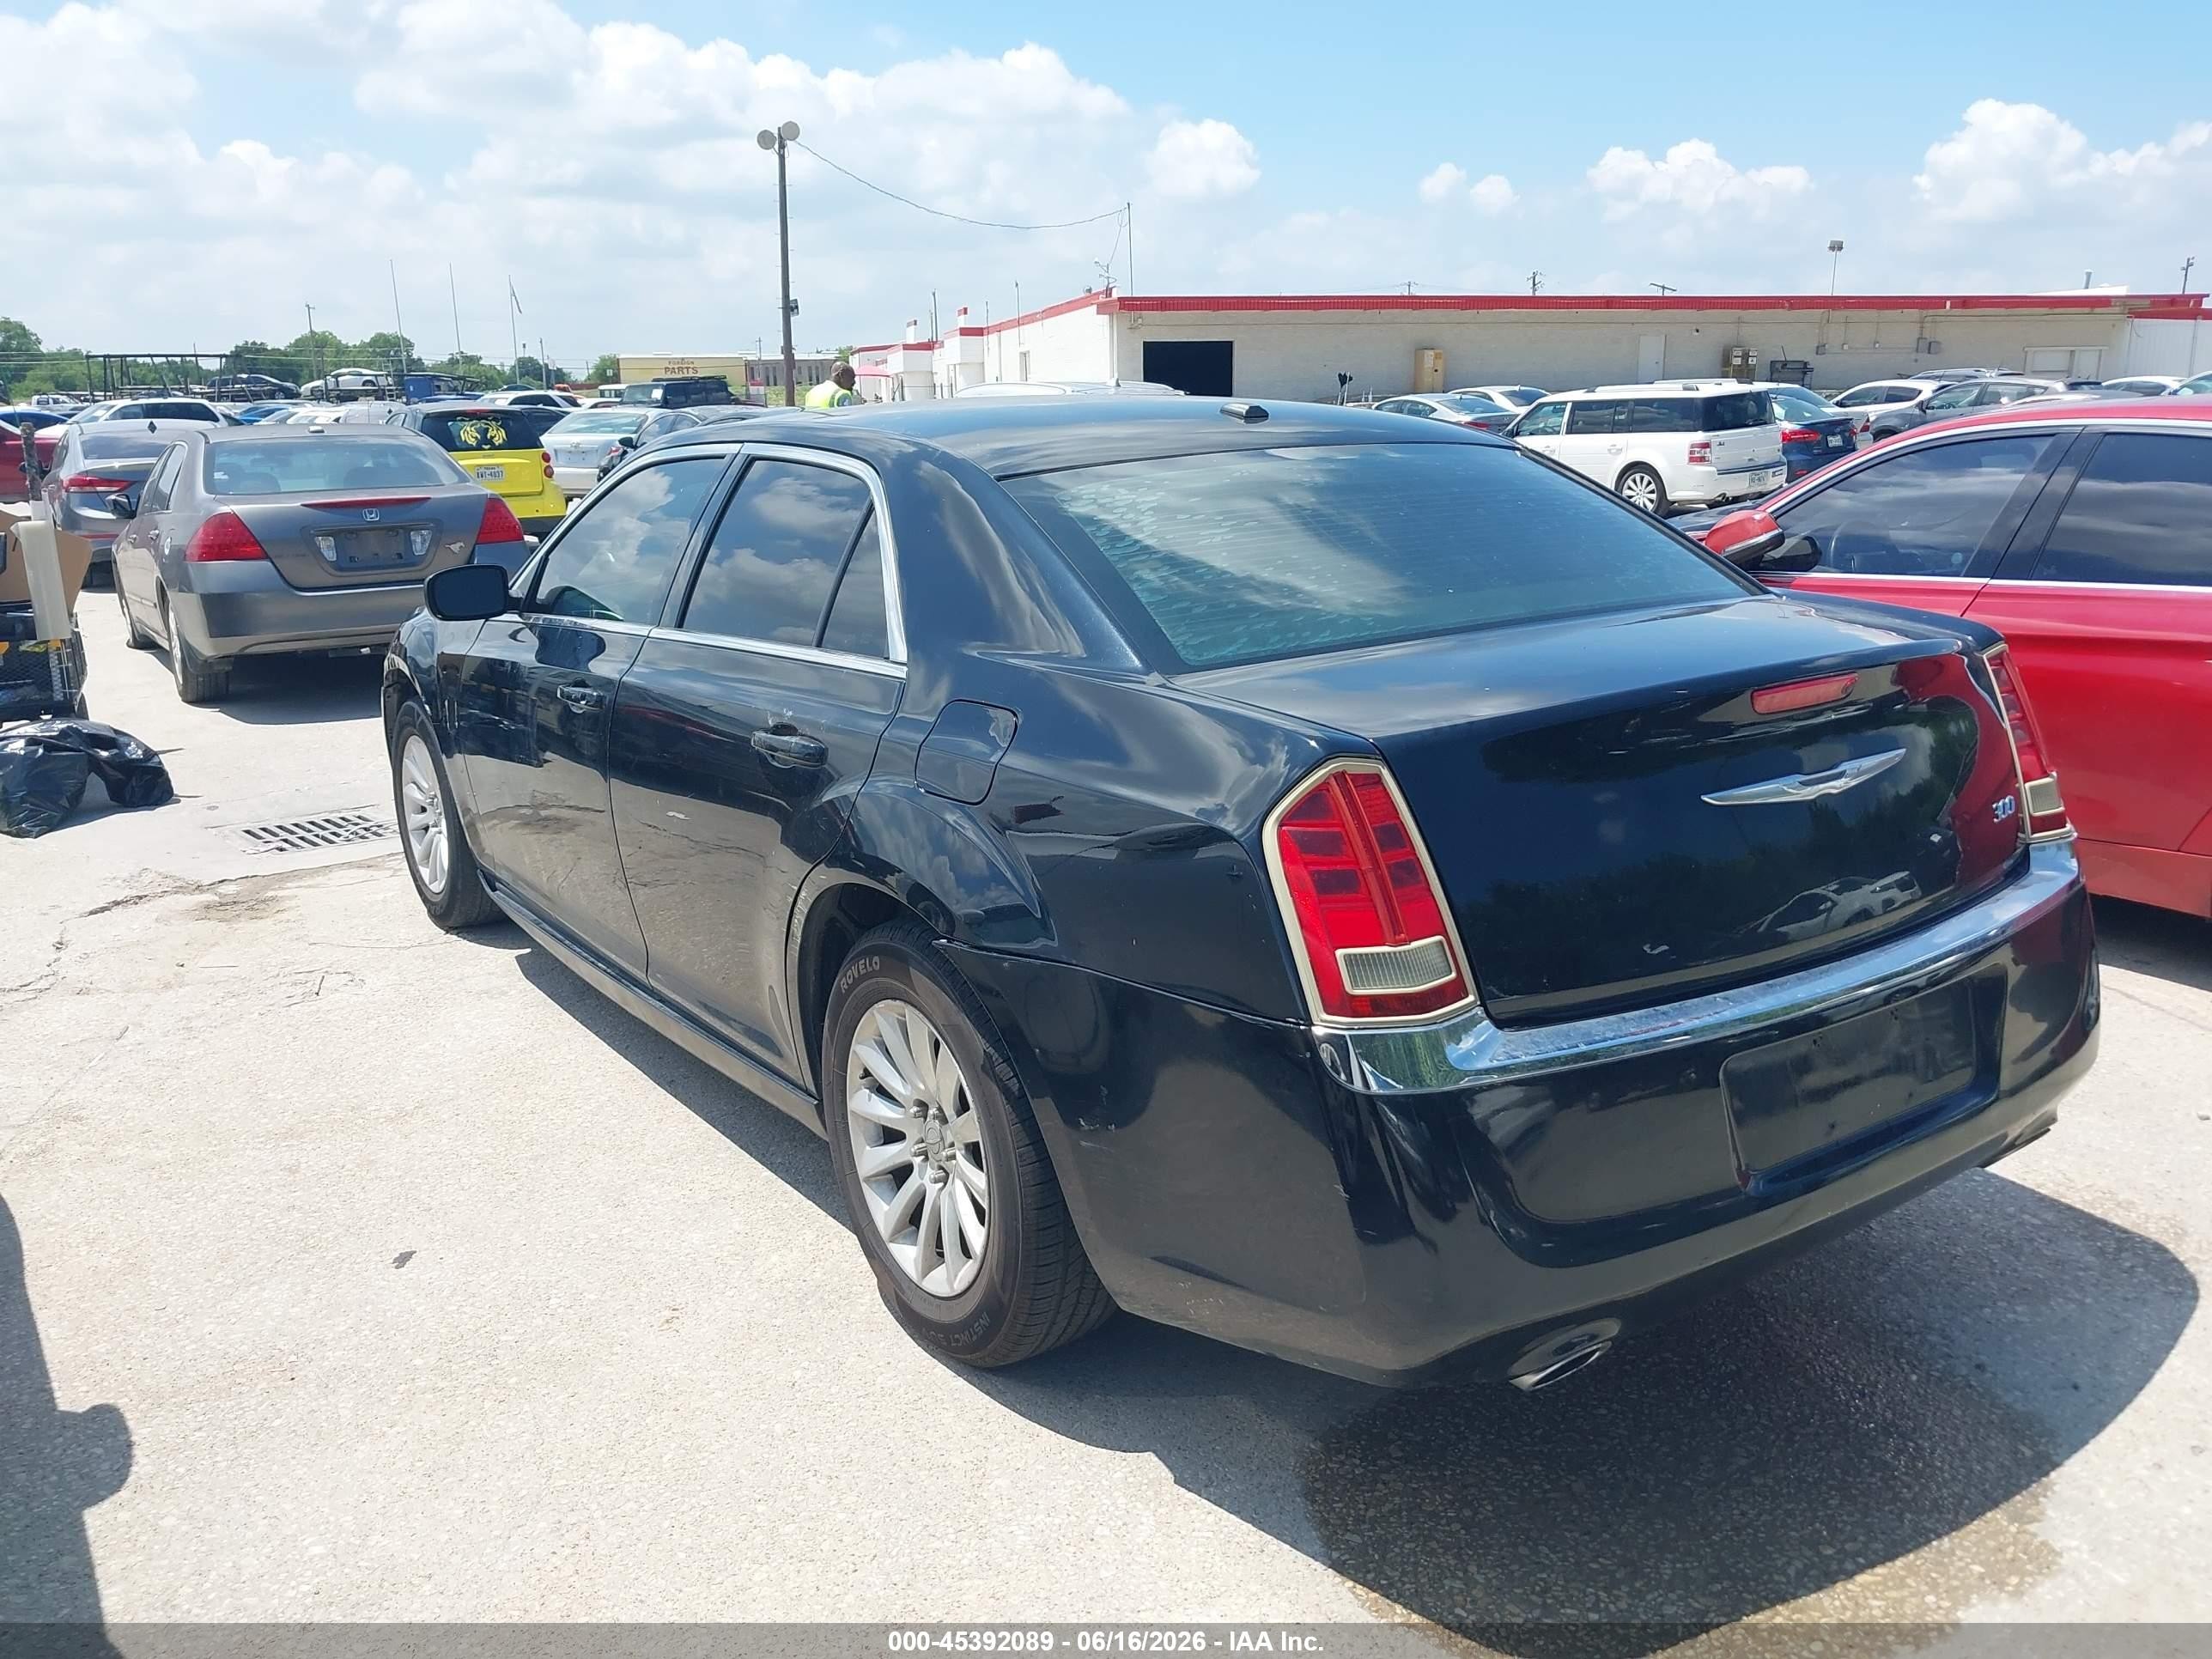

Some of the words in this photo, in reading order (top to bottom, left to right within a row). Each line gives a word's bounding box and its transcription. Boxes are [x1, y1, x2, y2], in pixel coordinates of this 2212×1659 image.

[664, 366, 699, 375] PARTS
[1992, 794, 2015, 823] 300
[840, 955, 880, 994] ROVELO
